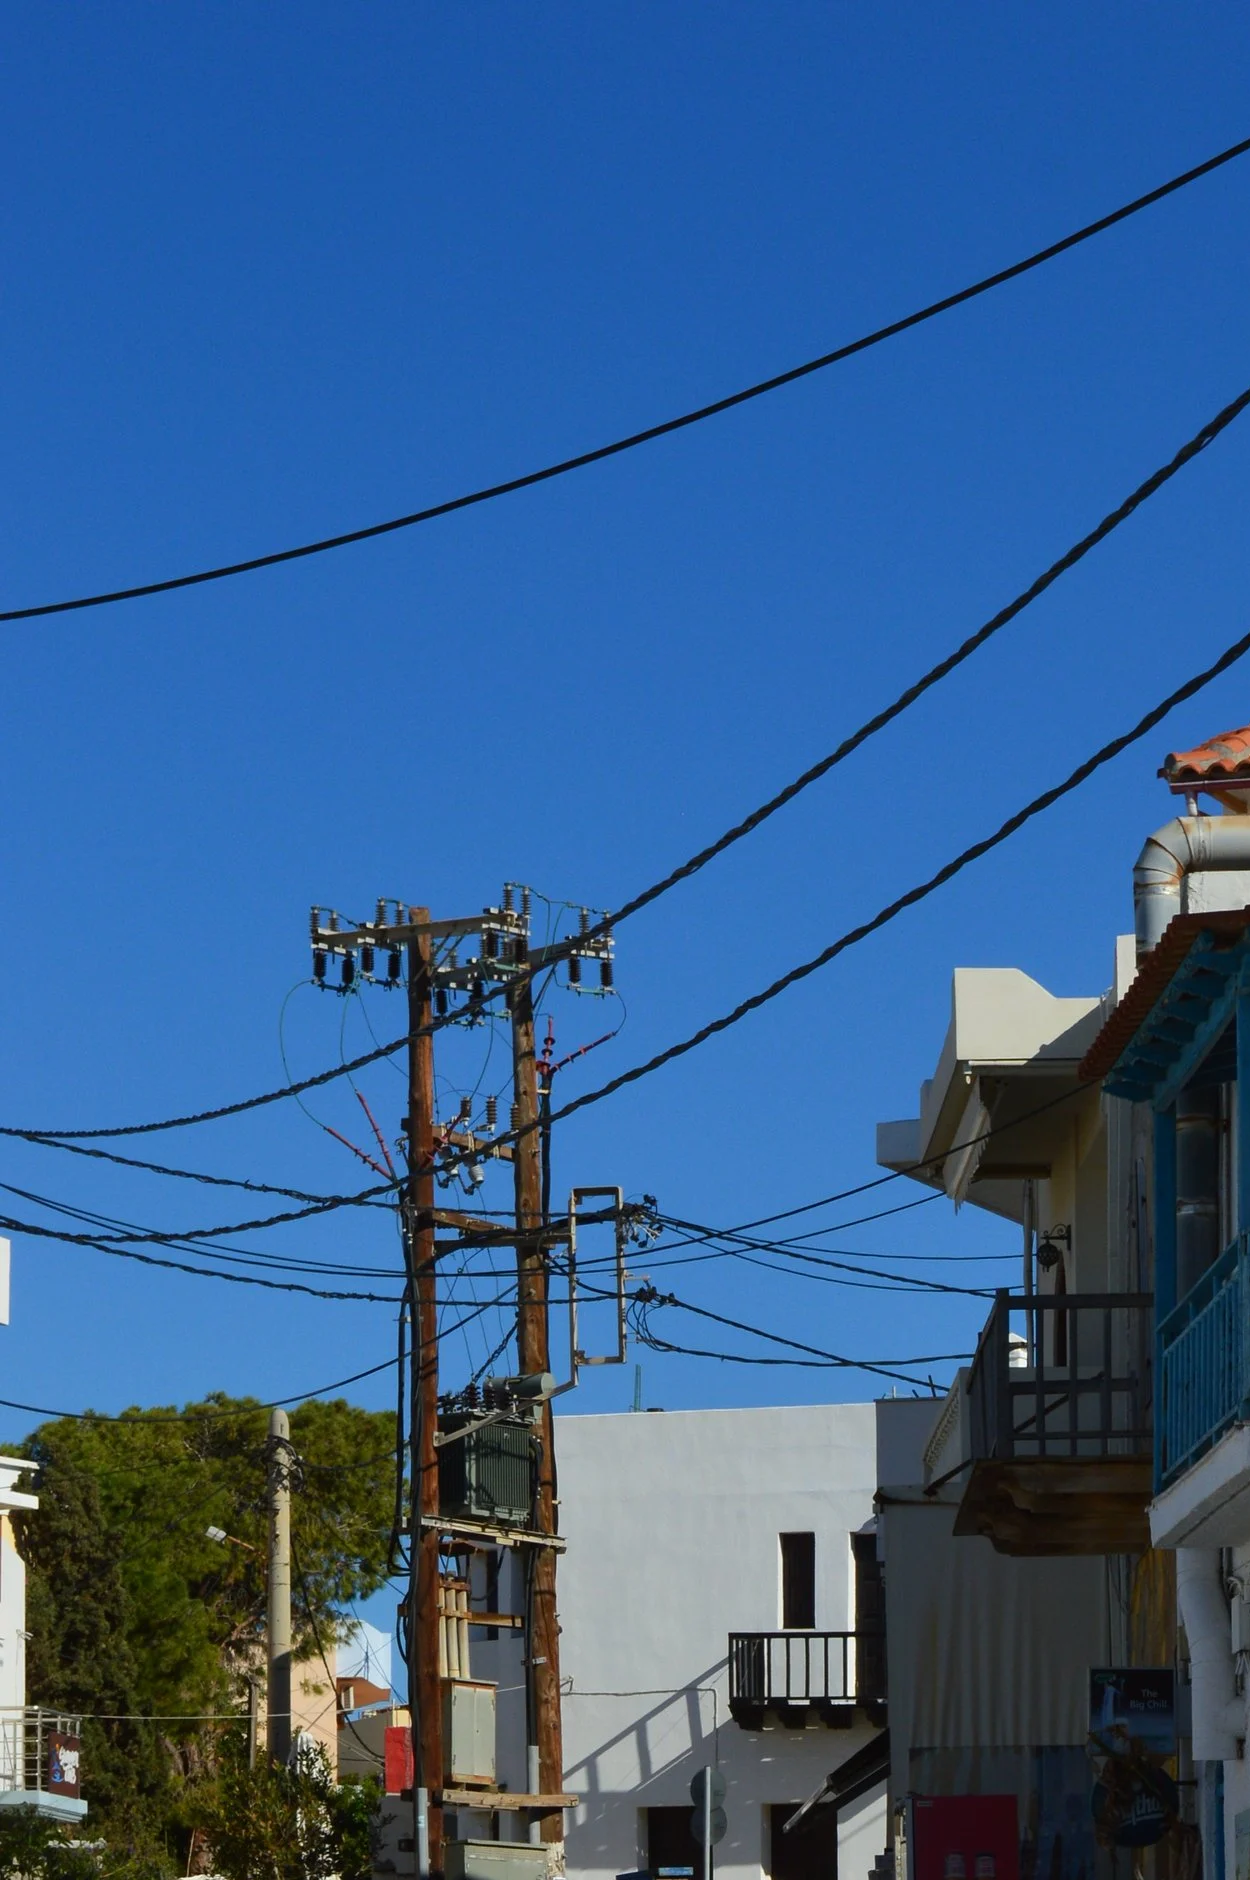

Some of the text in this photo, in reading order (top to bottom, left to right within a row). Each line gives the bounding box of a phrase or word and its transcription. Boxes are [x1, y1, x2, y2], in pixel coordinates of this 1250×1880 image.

[1140, 1688, 1158, 1698] The
[1129, 1699, 1167, 1711] Big Chill
